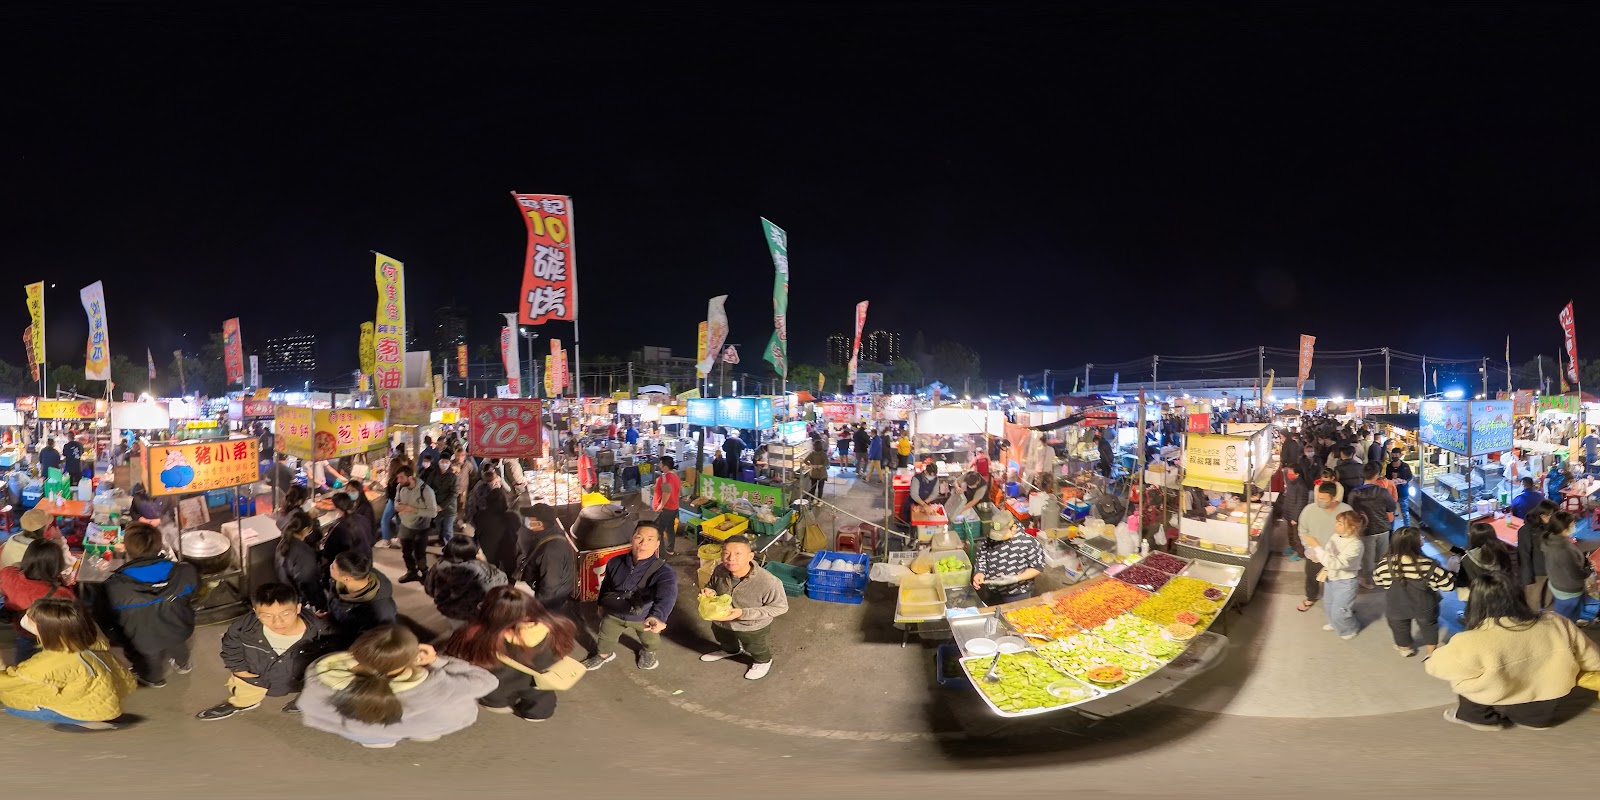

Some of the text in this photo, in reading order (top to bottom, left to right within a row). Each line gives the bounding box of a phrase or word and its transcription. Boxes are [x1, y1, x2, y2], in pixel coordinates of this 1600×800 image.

[526, 210, 566, 243] 10
[527, 244, 567, 319] 碳烤
[480, 421, 520, 447] 10
[195, 441, 247, 465] 豬小弟
